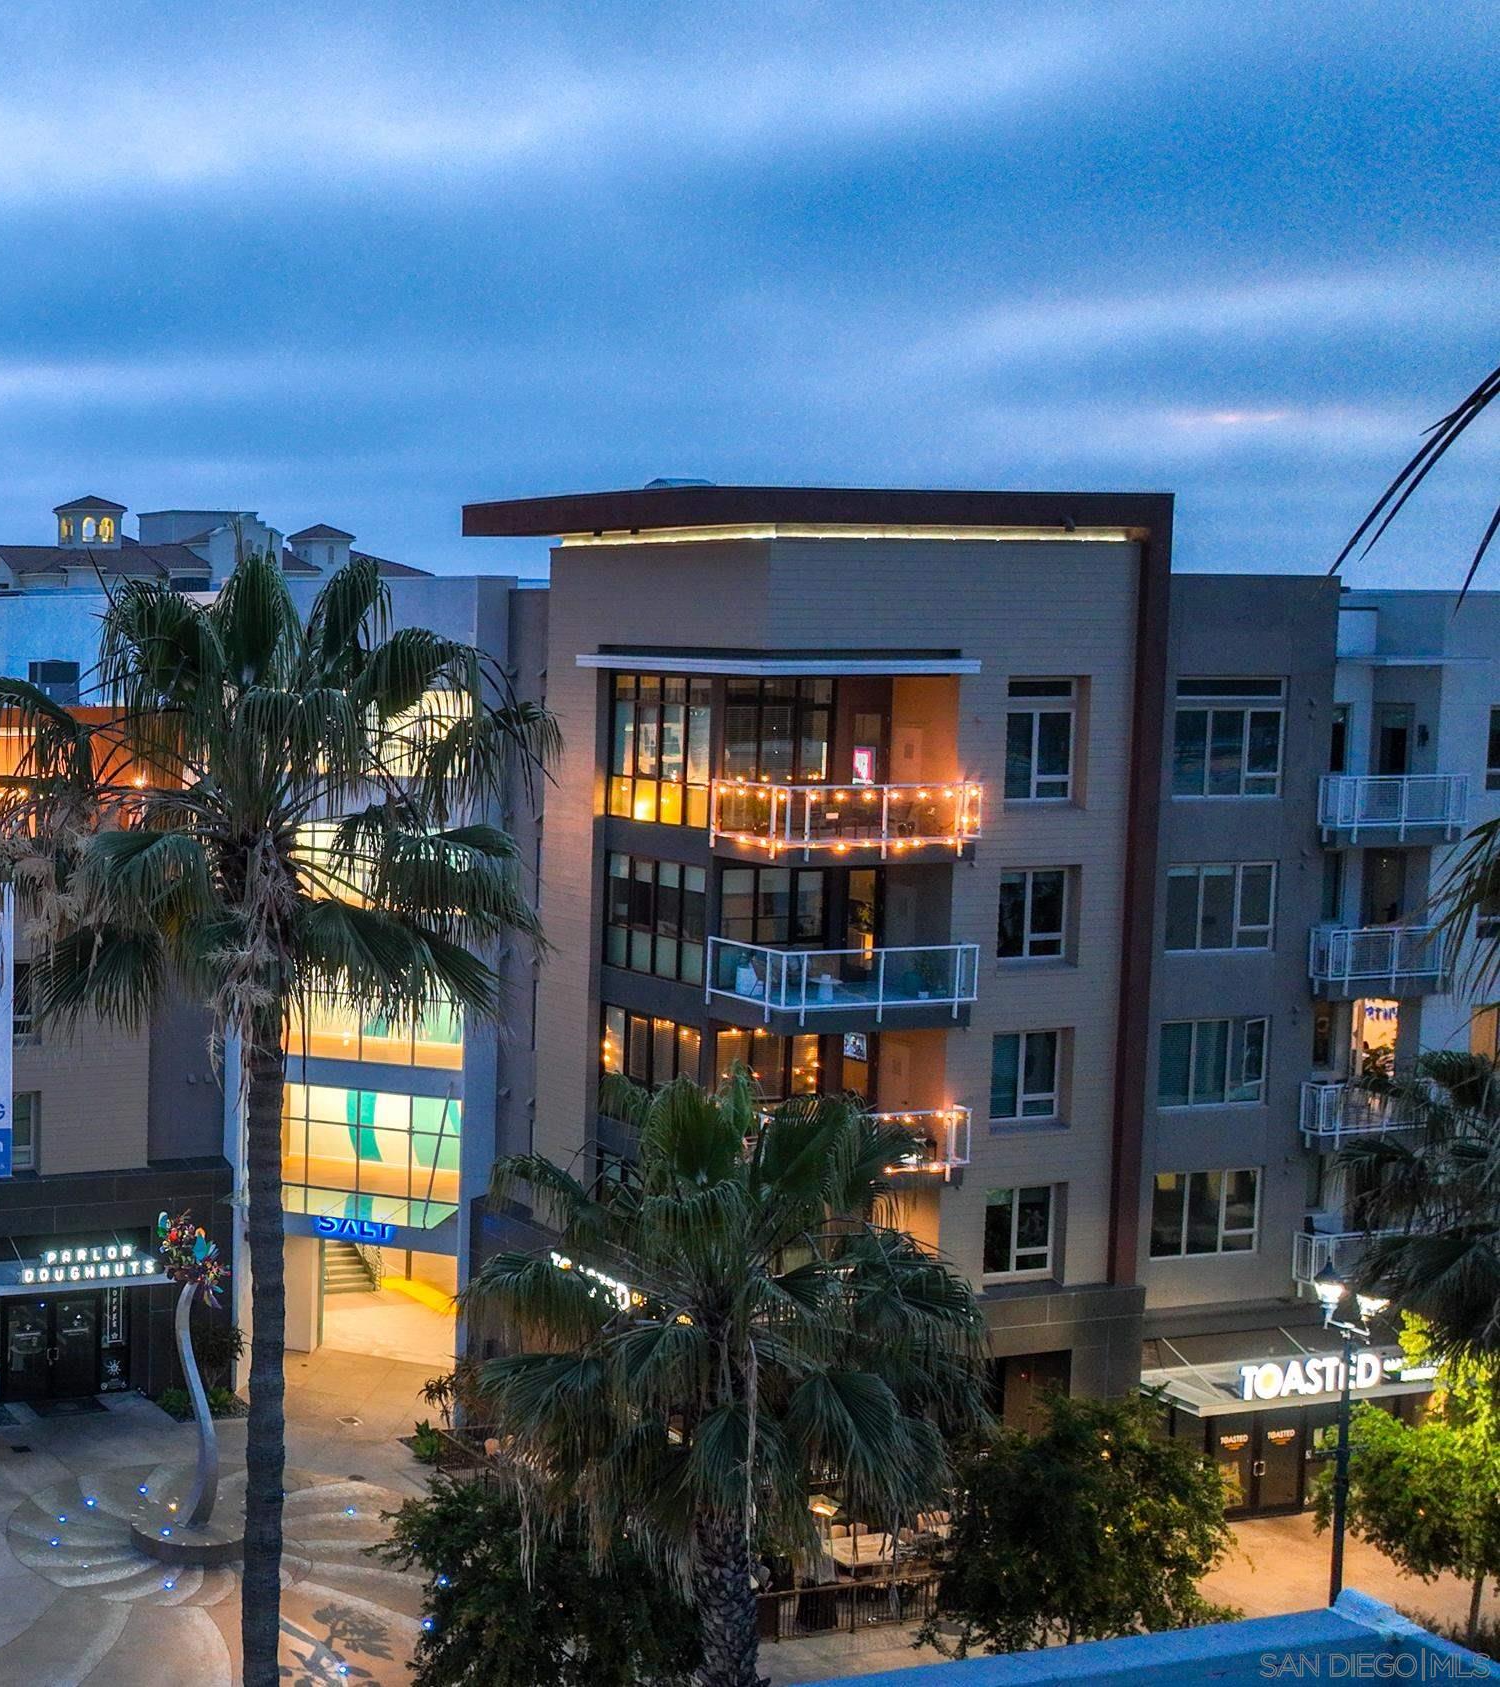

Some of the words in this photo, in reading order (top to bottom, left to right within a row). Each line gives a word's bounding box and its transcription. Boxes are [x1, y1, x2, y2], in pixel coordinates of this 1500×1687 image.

[46, 1244, 133, 1264] PARLOR
[23, 1260, 156, 1284] DOUGHNUTS
[1239, 1353, 1381, 1402] TOASTED
[1220, 1434, 1249, 1445] TOASTED
[1266, 1428, 1296, 1440] TOASTED
